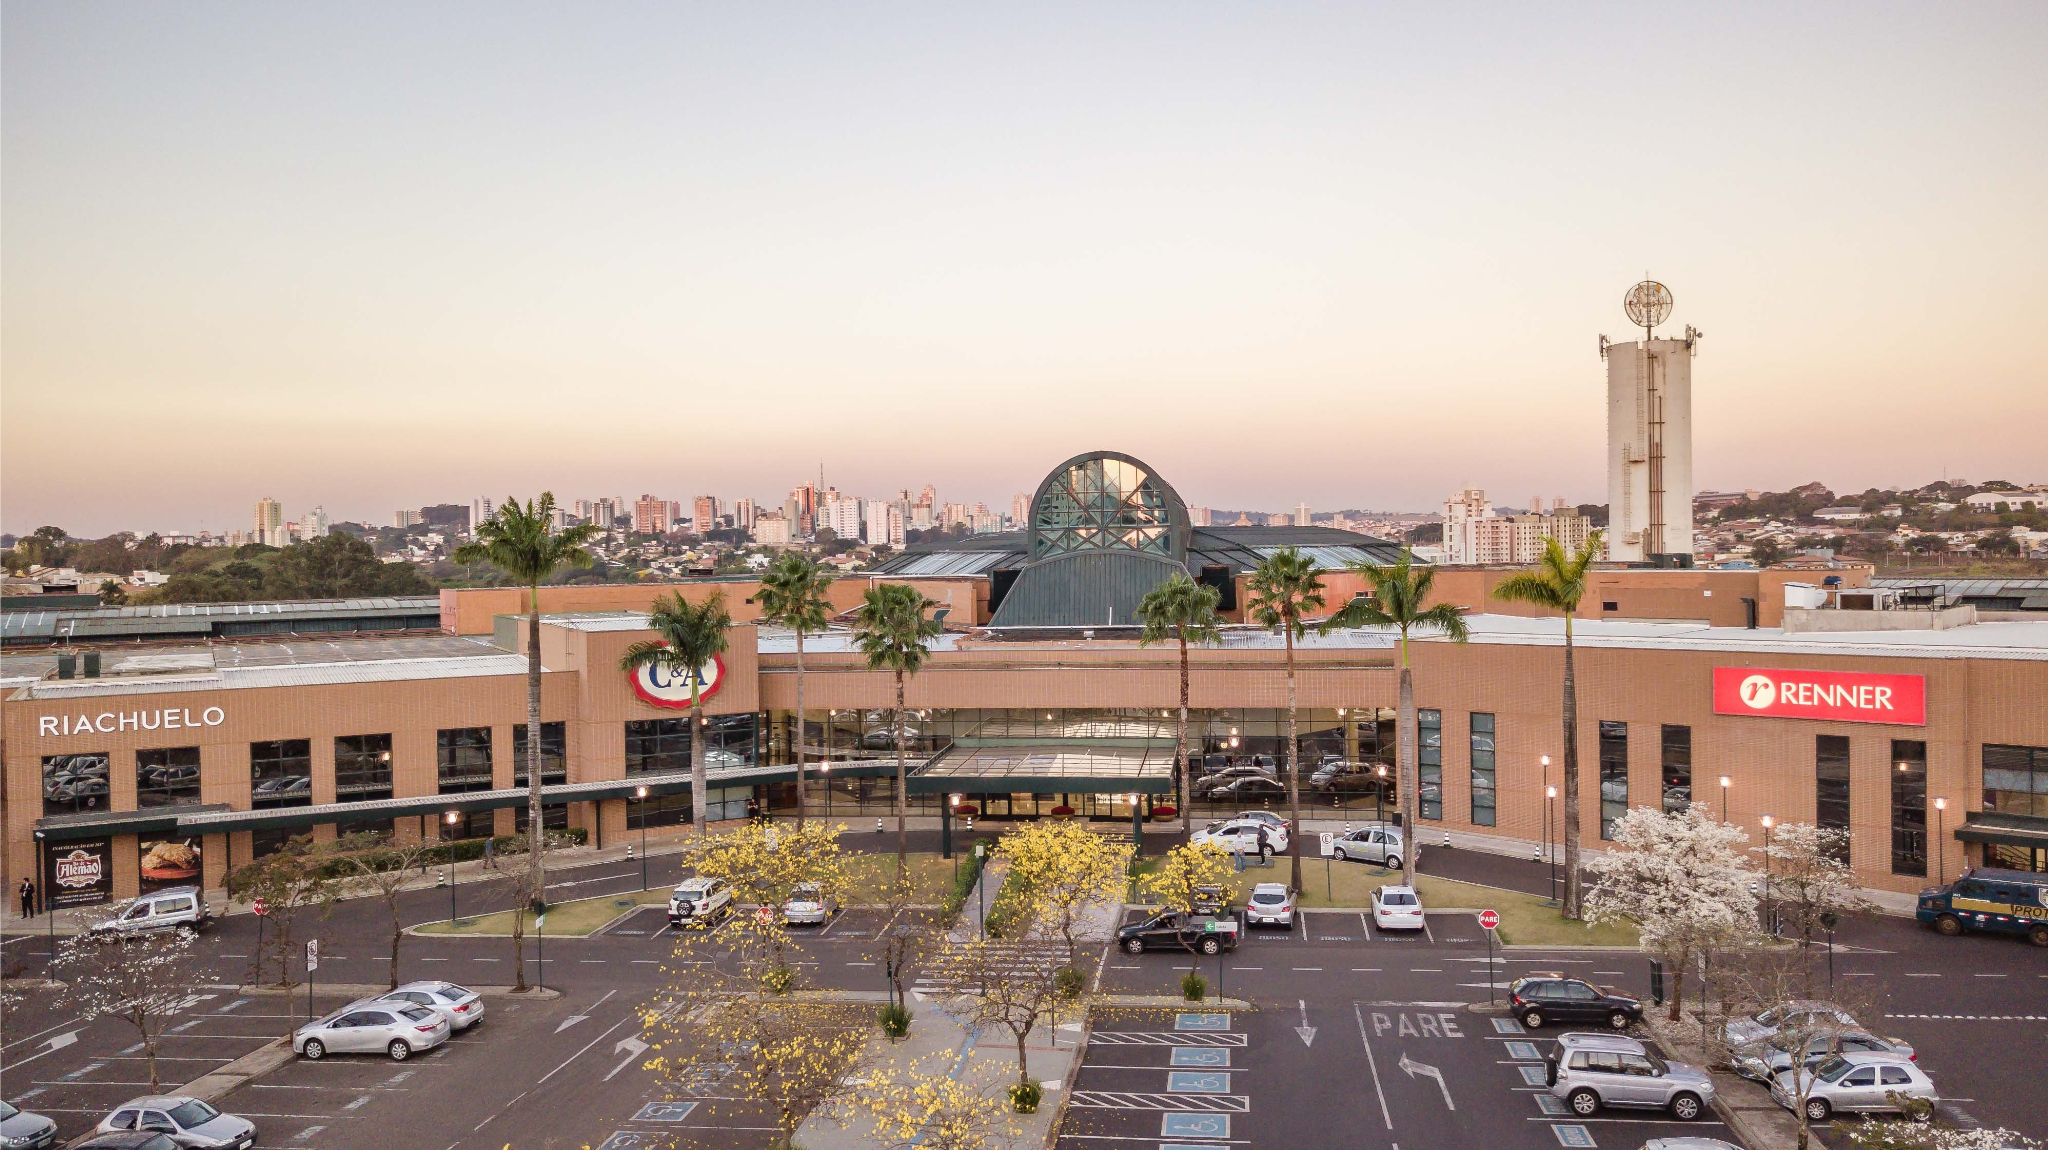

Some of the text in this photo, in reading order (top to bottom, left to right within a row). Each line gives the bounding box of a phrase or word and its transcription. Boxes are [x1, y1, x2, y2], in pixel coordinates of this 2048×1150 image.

[648, 656, 708, 689] C&A
[1780, 682, 1894, 710] RENNER
[39, 706, 225, 737] RIACHUELO
[59, 862, 99, 878] Alemão
[1371, 1012, 1465, 1038] PARE
